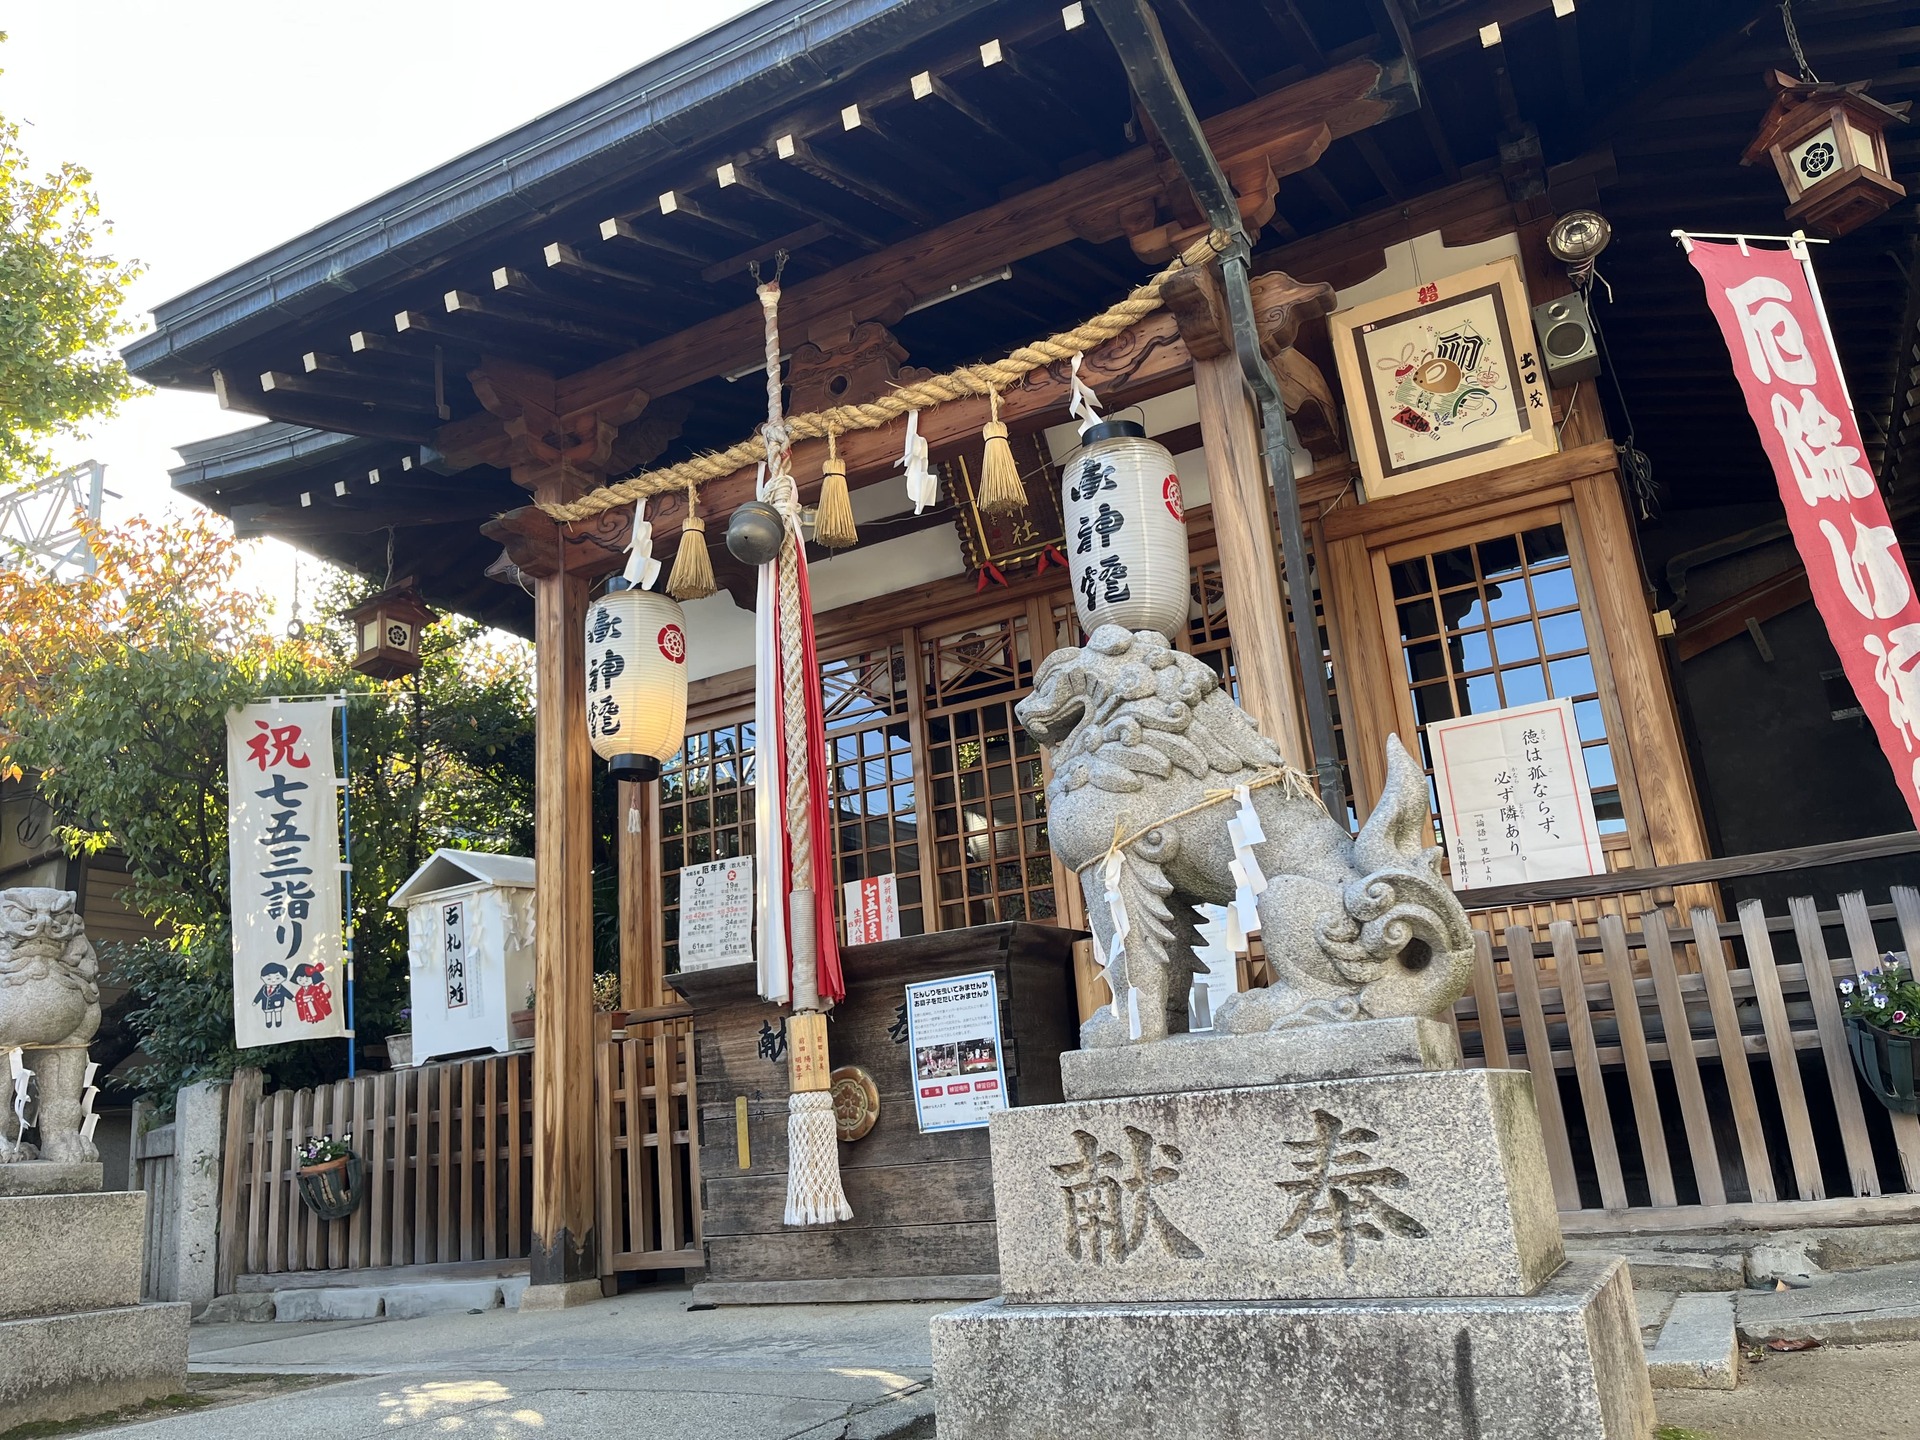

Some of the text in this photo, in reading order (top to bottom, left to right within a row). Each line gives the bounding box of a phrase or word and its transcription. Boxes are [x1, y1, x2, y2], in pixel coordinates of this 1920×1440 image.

[1520, 352, 1544, 409] 出口茂
[1494, 771, 1527, 862] 必ず隣あり。
[1522, 729, 1560, 839] 徳は孤ならず、
[246, 719, 316, 960] 祝 七五三詣り
[702, 862, 726, 874] 厄年表
[445, 906, 464, 1005] 古札納所
[1049, 1108, 1429, 1270] 奉 献
